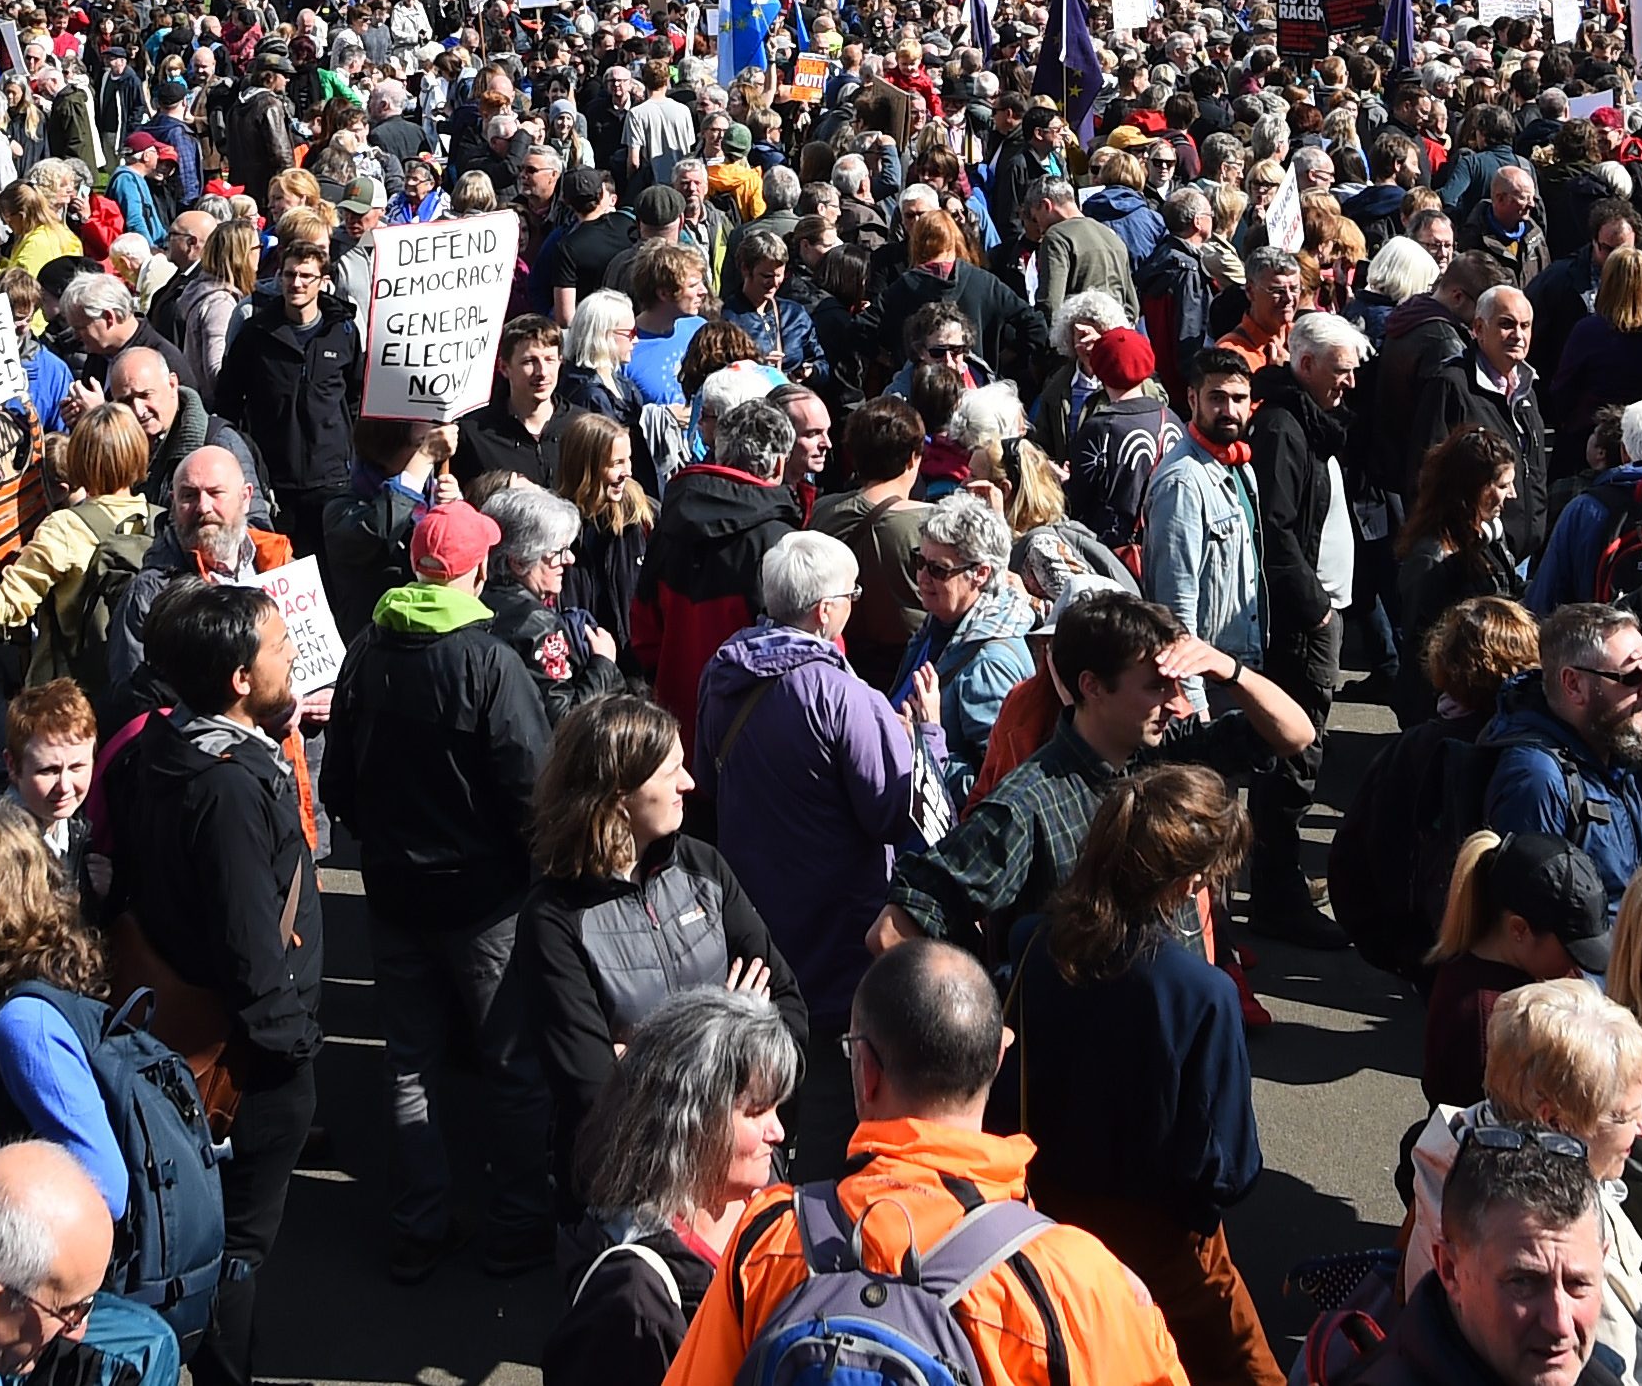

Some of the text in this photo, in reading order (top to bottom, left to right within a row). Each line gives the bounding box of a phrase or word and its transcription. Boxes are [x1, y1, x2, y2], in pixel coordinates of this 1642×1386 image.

[398, 229, 497, 266] DEFEND
[386, 305, 489, 337] GENERAL
[380, 330, 490, 368] ELECTION
